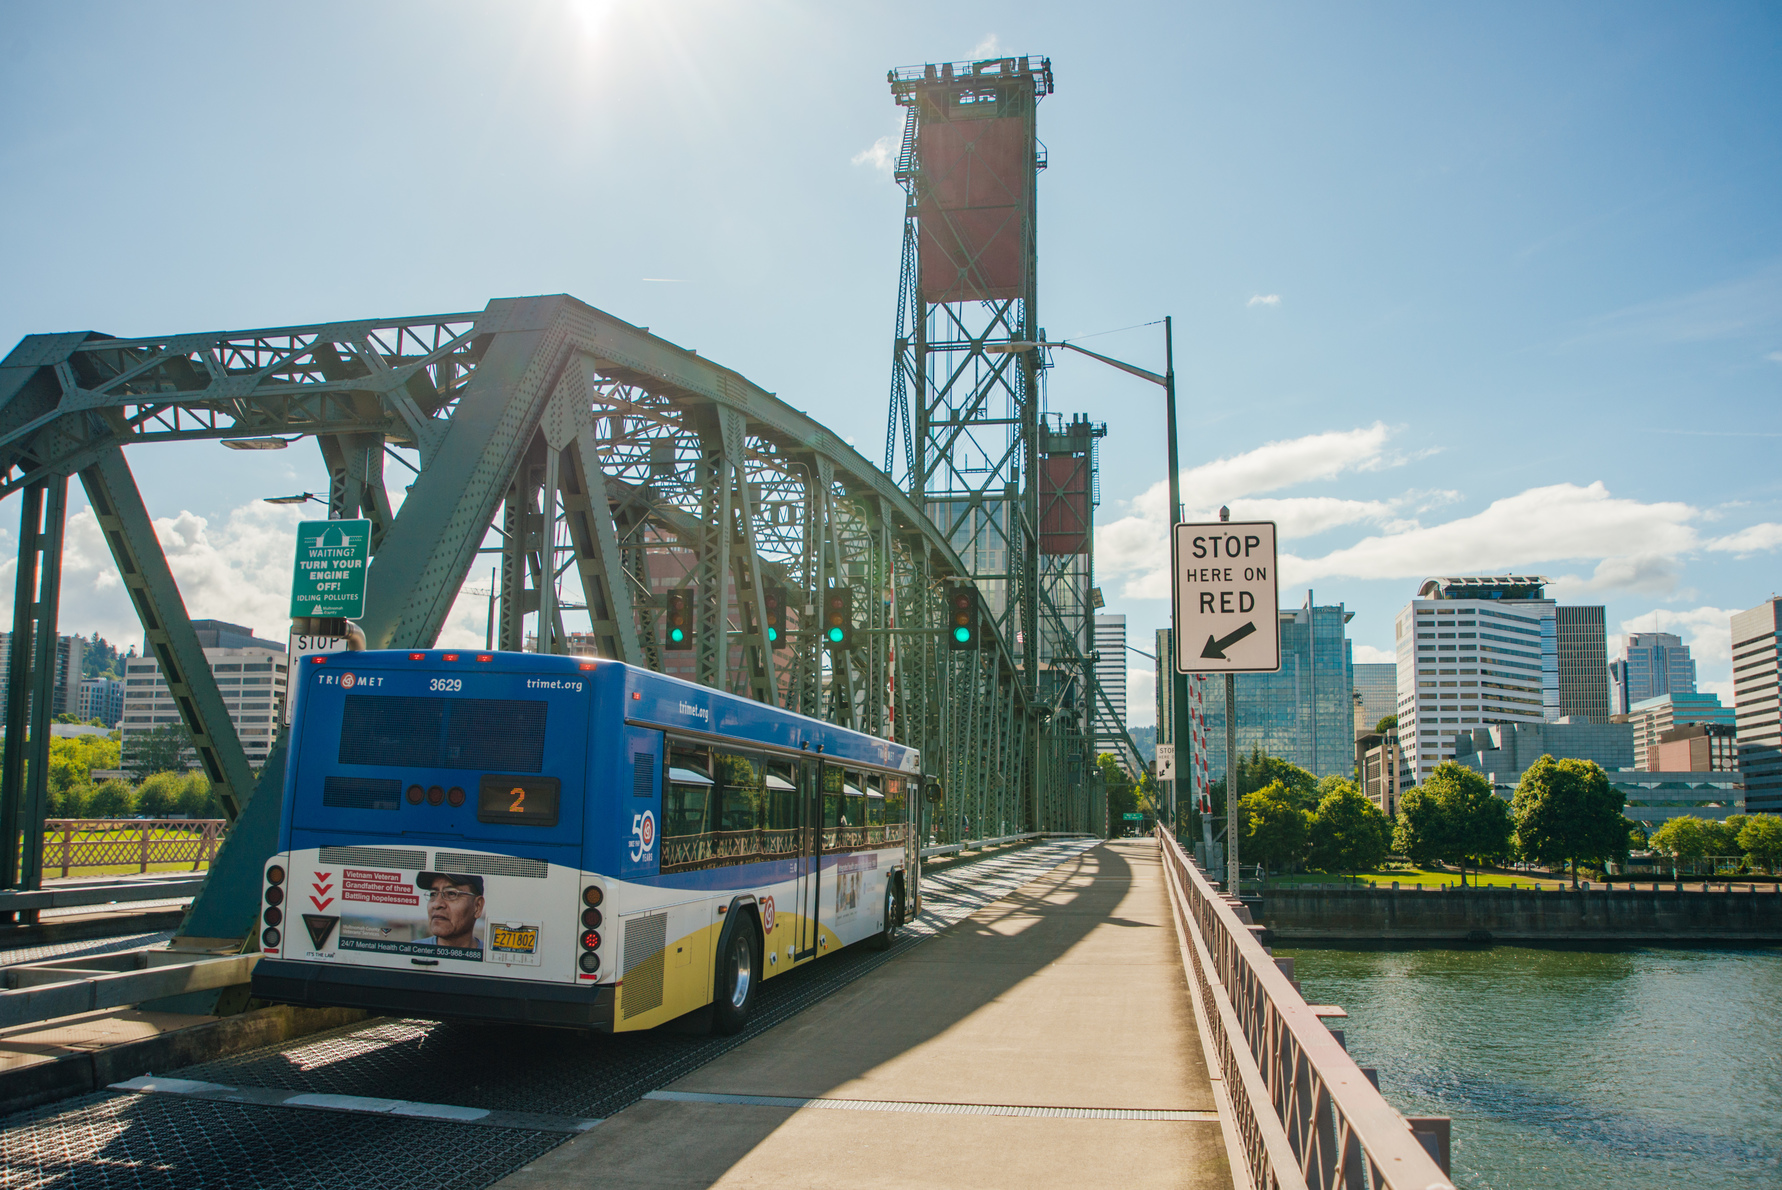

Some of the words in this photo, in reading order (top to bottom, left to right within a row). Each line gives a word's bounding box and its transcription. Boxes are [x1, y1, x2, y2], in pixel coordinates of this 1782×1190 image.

[309, 548, 355, 558] WAITING?
[1192, 535, 1260, 559] STOP
[300, 561, 328, 570] TURN
[332, 559, 362, 569] YOUR
[309, 570, 350, 580] ENGINE
[1187, 568, 1233, 582] HERE
[1244, 567, 1266, 581] ON
[316, 582, 341, 591] OFF!
[296, 594, 321, 602] IDLING
[324, 593, 359, 601] POLLUTES
[1200, 591, 1255, 614] RED
[429, 678, 462, 692] 3629
[526, 678, 583, 693] trimet.org
[679, 700, 709, 723] trimet.org
[509, 787, 525, 812] 2
[631, 810, 655, 863] 50
[346, 870, 373, 879] Vietnam
[373, 872, 399, 881] Veteran
[345, 881, 384, 890] Grandfather
[393, 885, 411, 893] three
[344, 892, 370, 902] Battling
[371, 894, 417, 904] hopelessness
[494, 932, 535, 947] E271802
[341, 939, 354, 947] 24/7
[355, 941, 377, 949] Mental
[377, 942, 398, 951] Health
[398, 944, 411, 952] Call
[412, 945, 436, 955] Center:
[436, 948, 482, 959] 503-988-4888
